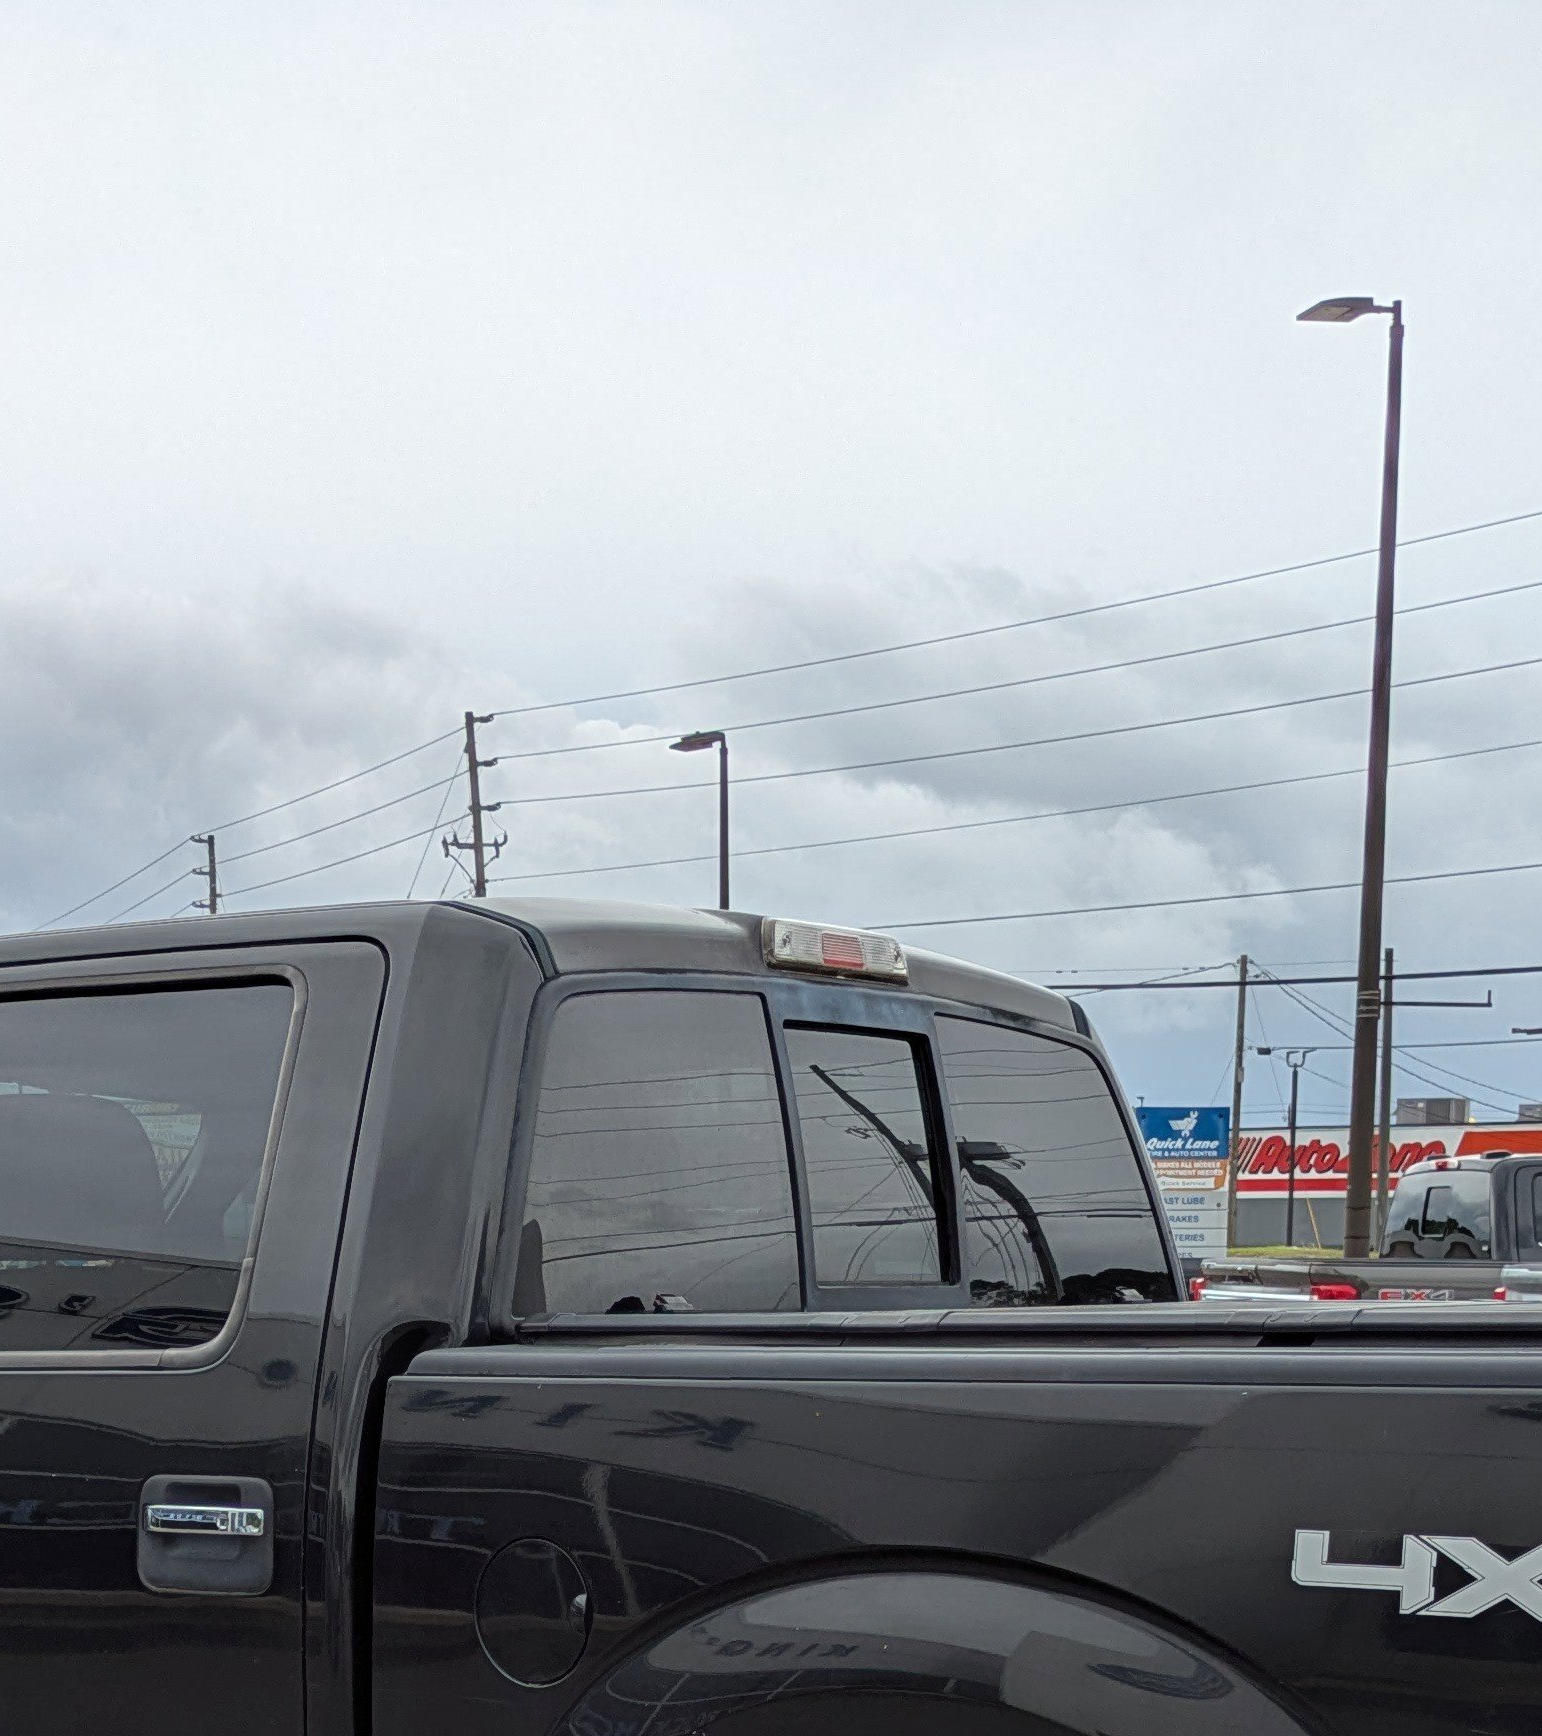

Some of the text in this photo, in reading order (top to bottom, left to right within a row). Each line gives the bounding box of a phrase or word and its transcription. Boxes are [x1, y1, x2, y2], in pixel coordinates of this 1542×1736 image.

[1146, 1137, 1219, 1151] Quick Lane
[1181, 1197, 1206, 1205] LUBE
[1168, 1215, 1199, 1223] RAKES
[1174, 1233, 1205, 1242] TERIES
